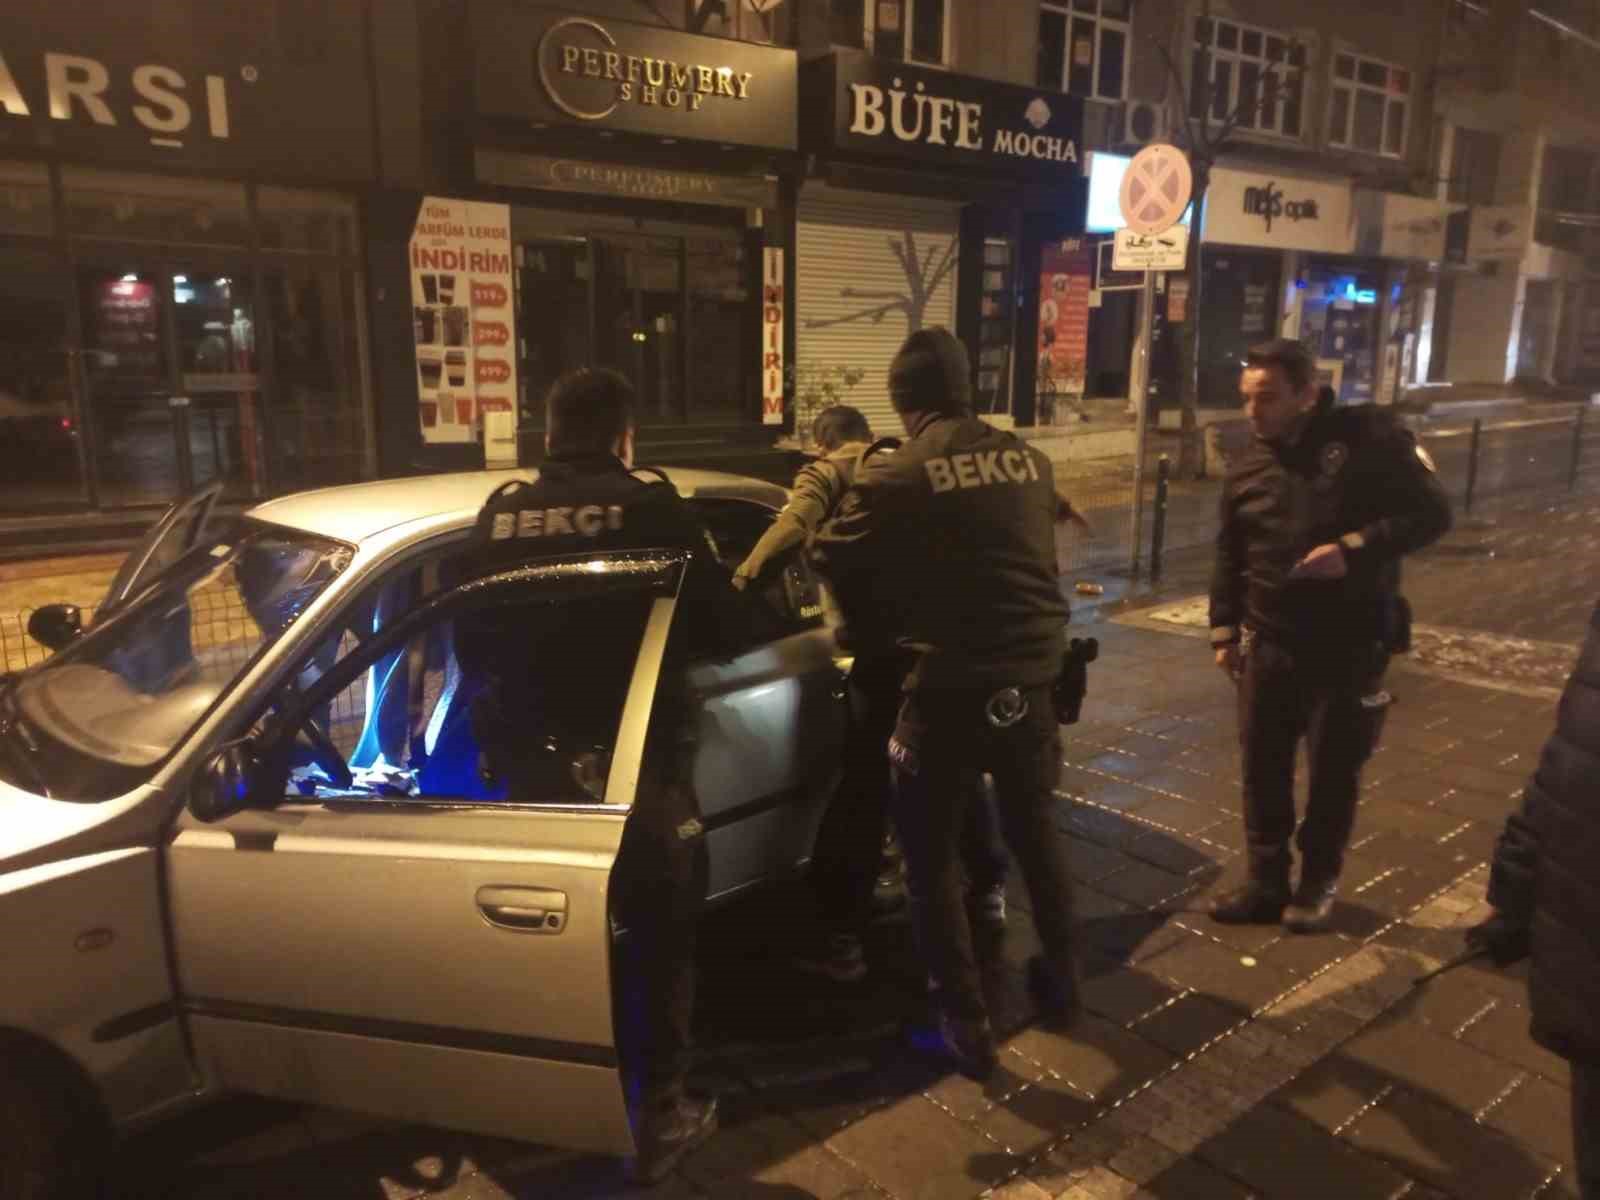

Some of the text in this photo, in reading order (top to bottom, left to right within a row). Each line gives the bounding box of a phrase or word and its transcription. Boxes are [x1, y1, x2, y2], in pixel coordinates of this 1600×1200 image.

[562, 45, 753, 99] PERFUMERY
[620, 83, 703, 110] SHOP
[849, 77, 983, 150] BÜFE
[993, 129, 1078, 163] MOCHA
[925, 449, 1038, 493] BEKÇİ
